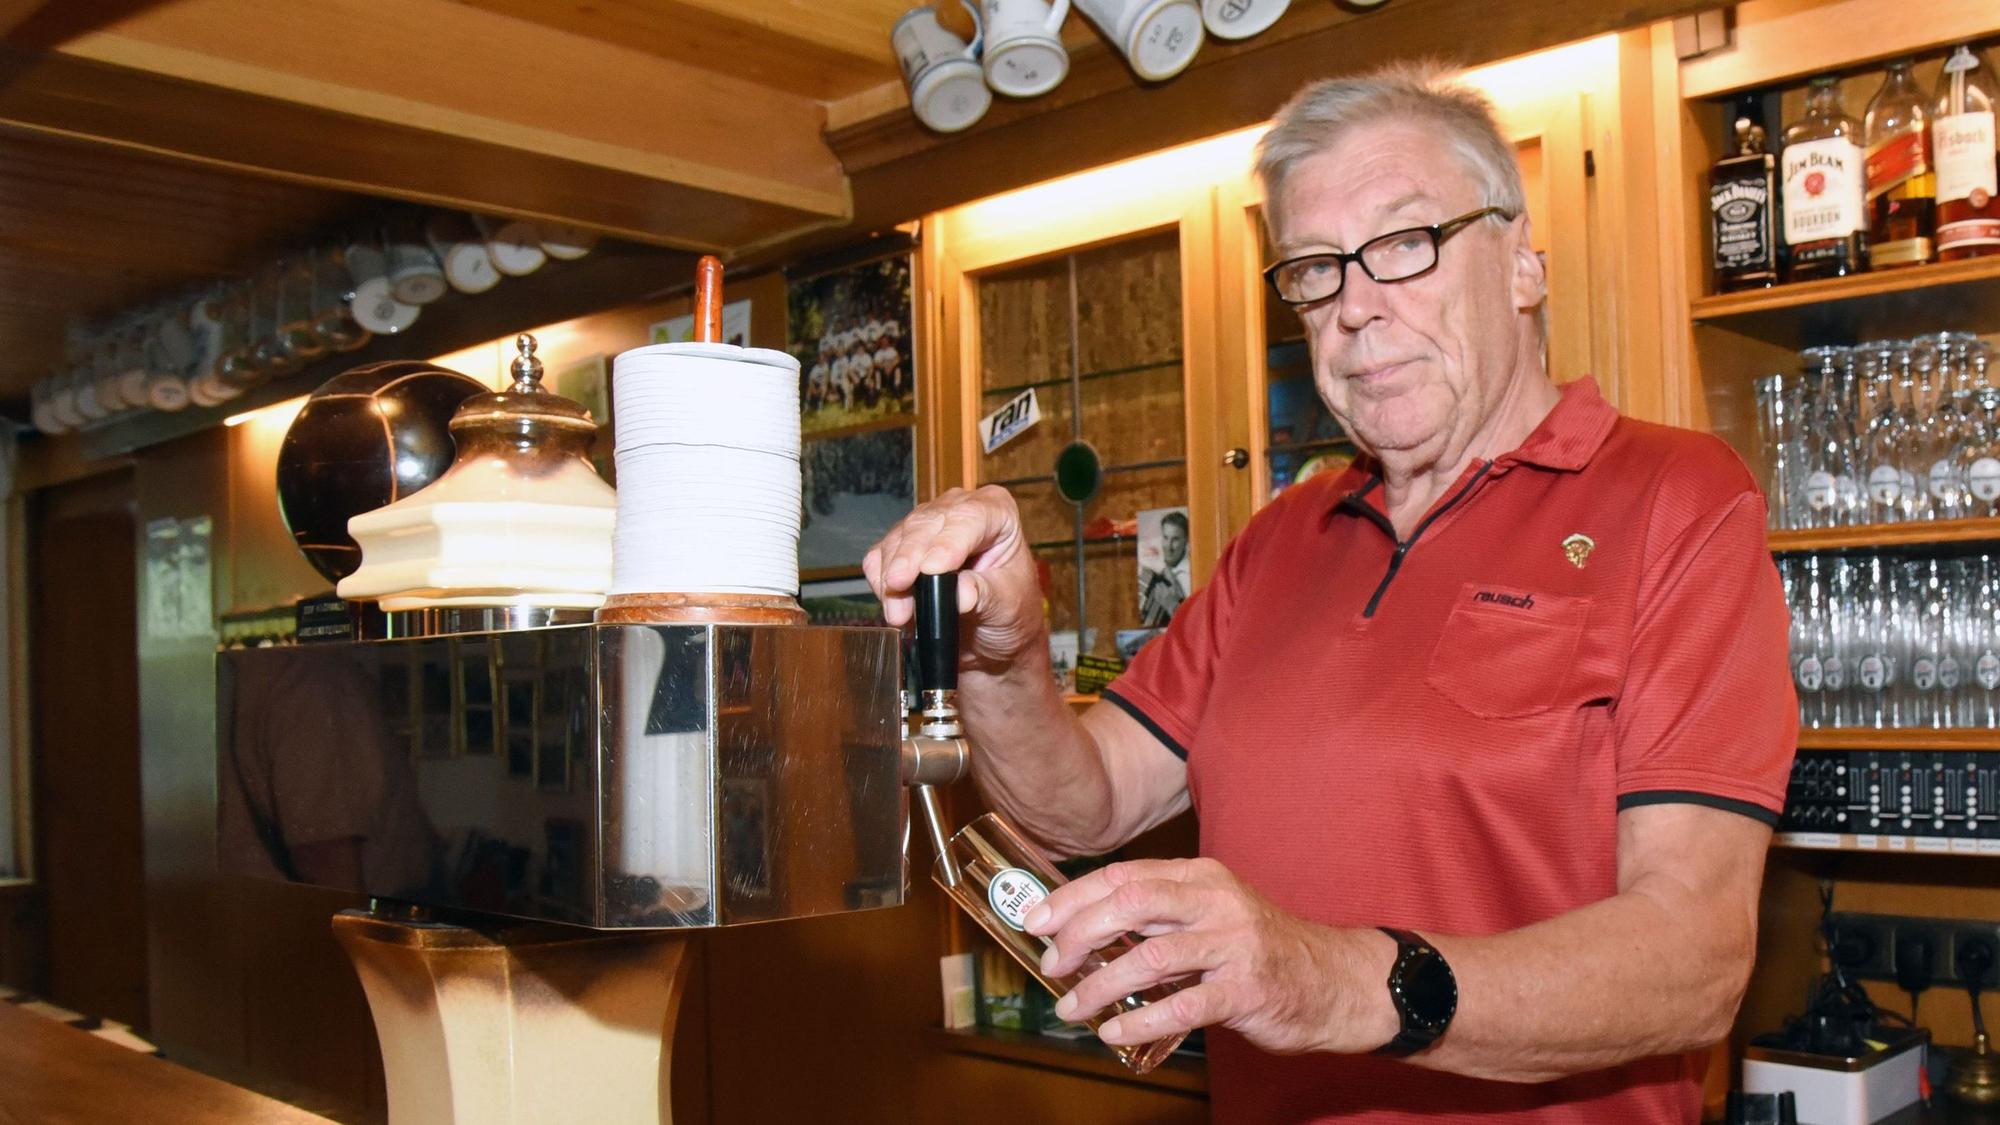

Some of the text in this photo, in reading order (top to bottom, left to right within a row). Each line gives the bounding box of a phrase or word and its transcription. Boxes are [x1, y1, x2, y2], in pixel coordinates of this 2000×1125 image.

[1786, 159, 1808, 182] JIM
[1809, 151, 1844, 172] BEAM
[990, 392, 1032, 438] ran
[1472, 591, 1535, 610] rausch
